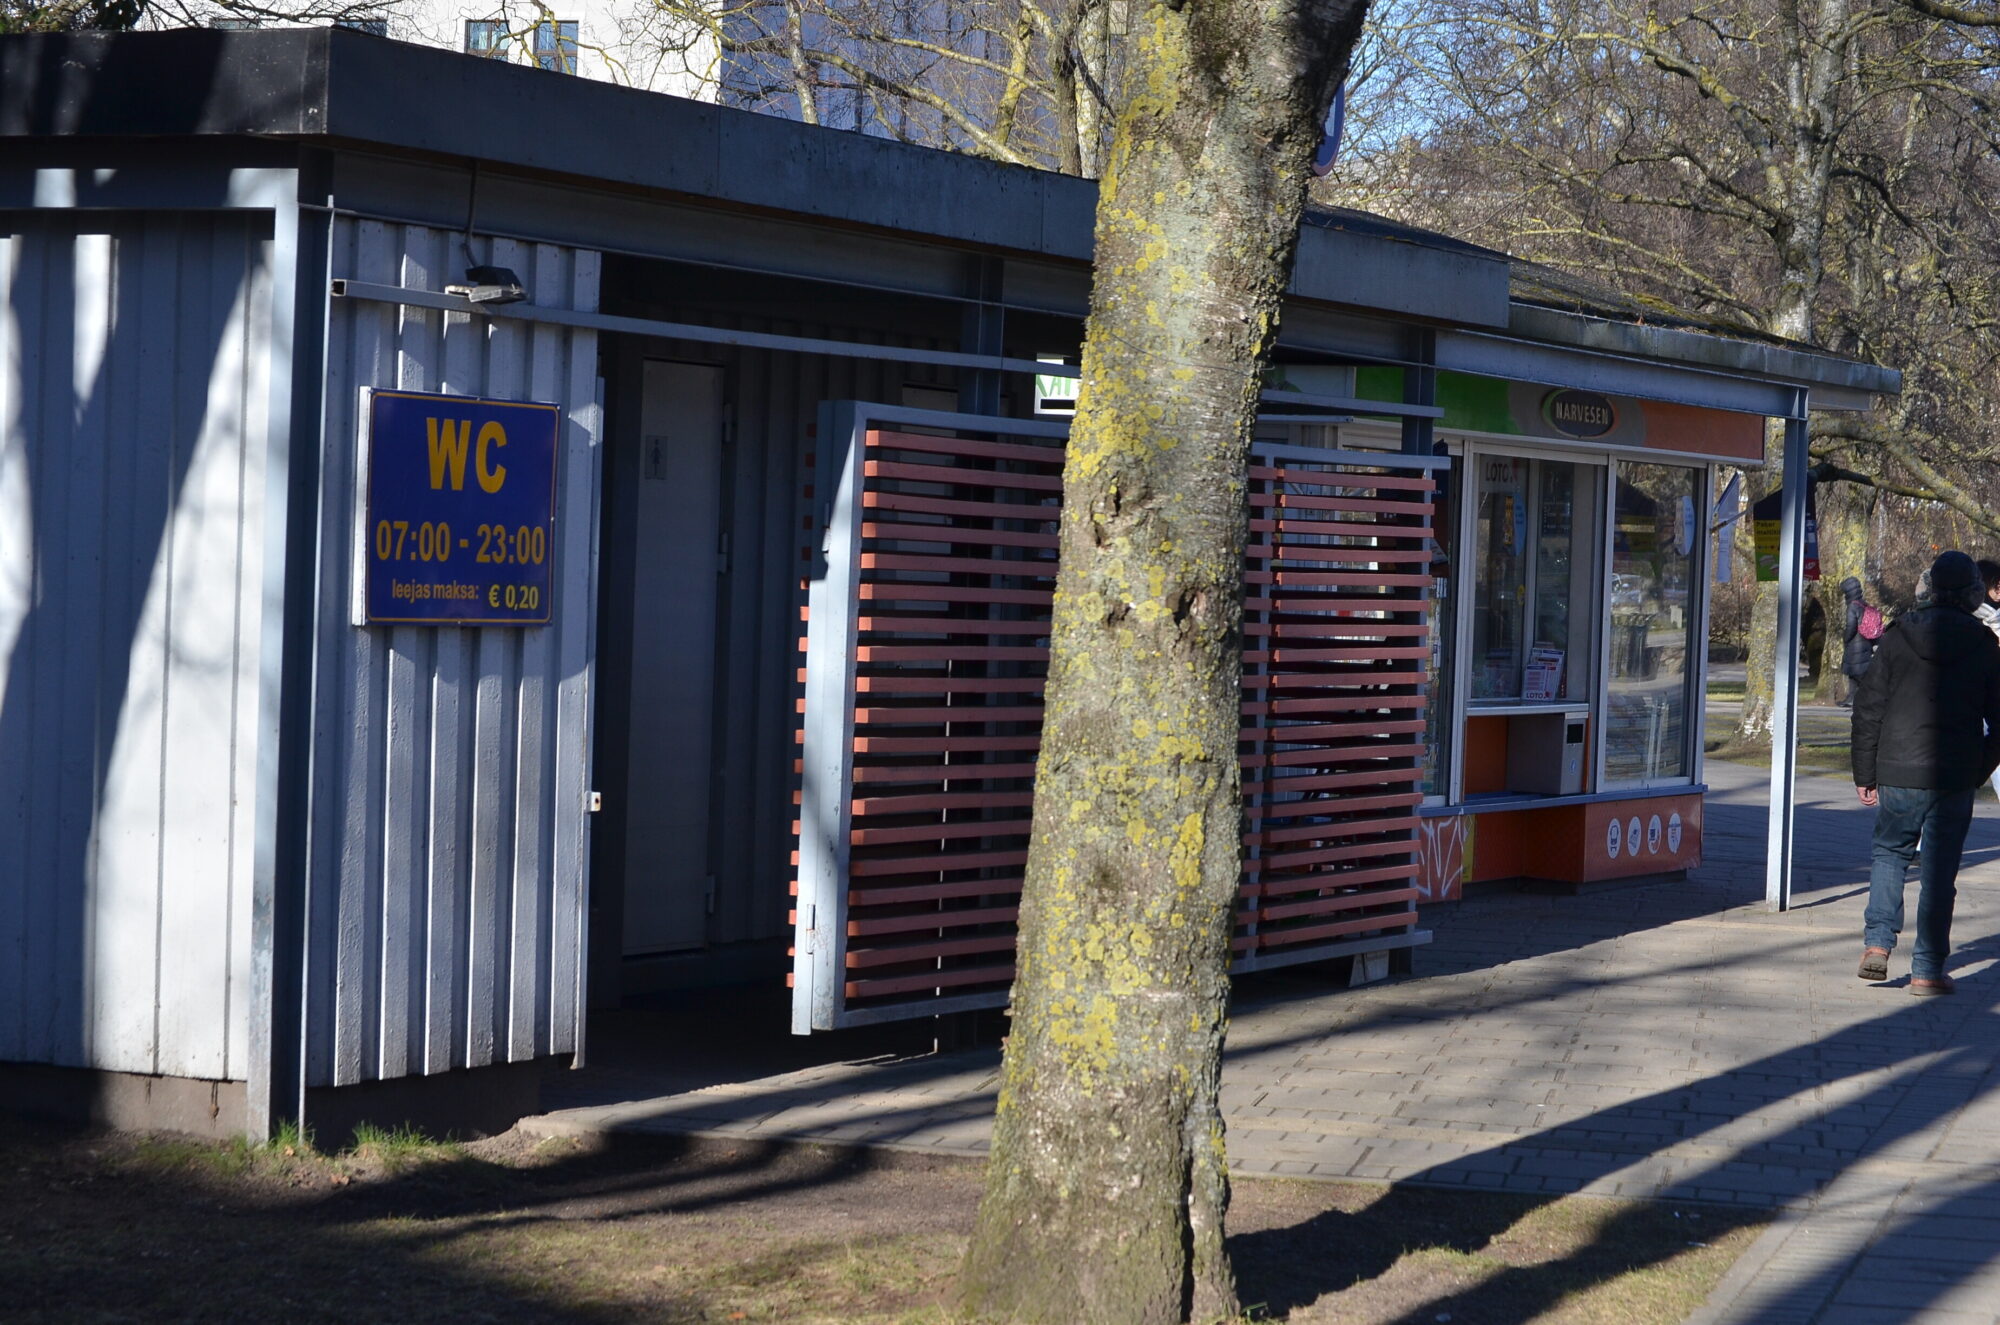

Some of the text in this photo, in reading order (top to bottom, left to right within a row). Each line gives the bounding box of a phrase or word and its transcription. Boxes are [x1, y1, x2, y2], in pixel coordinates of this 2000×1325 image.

[1555, 401, 1608, 425] NARVESEN
[426, 417, 507, 493] WC
[376, 520, 450, 562] 07:00
[475, 524, 546, 565] 23:00
[433, 580, 479, 599] maksa:
[505, 586, 539, 611] 0,20
